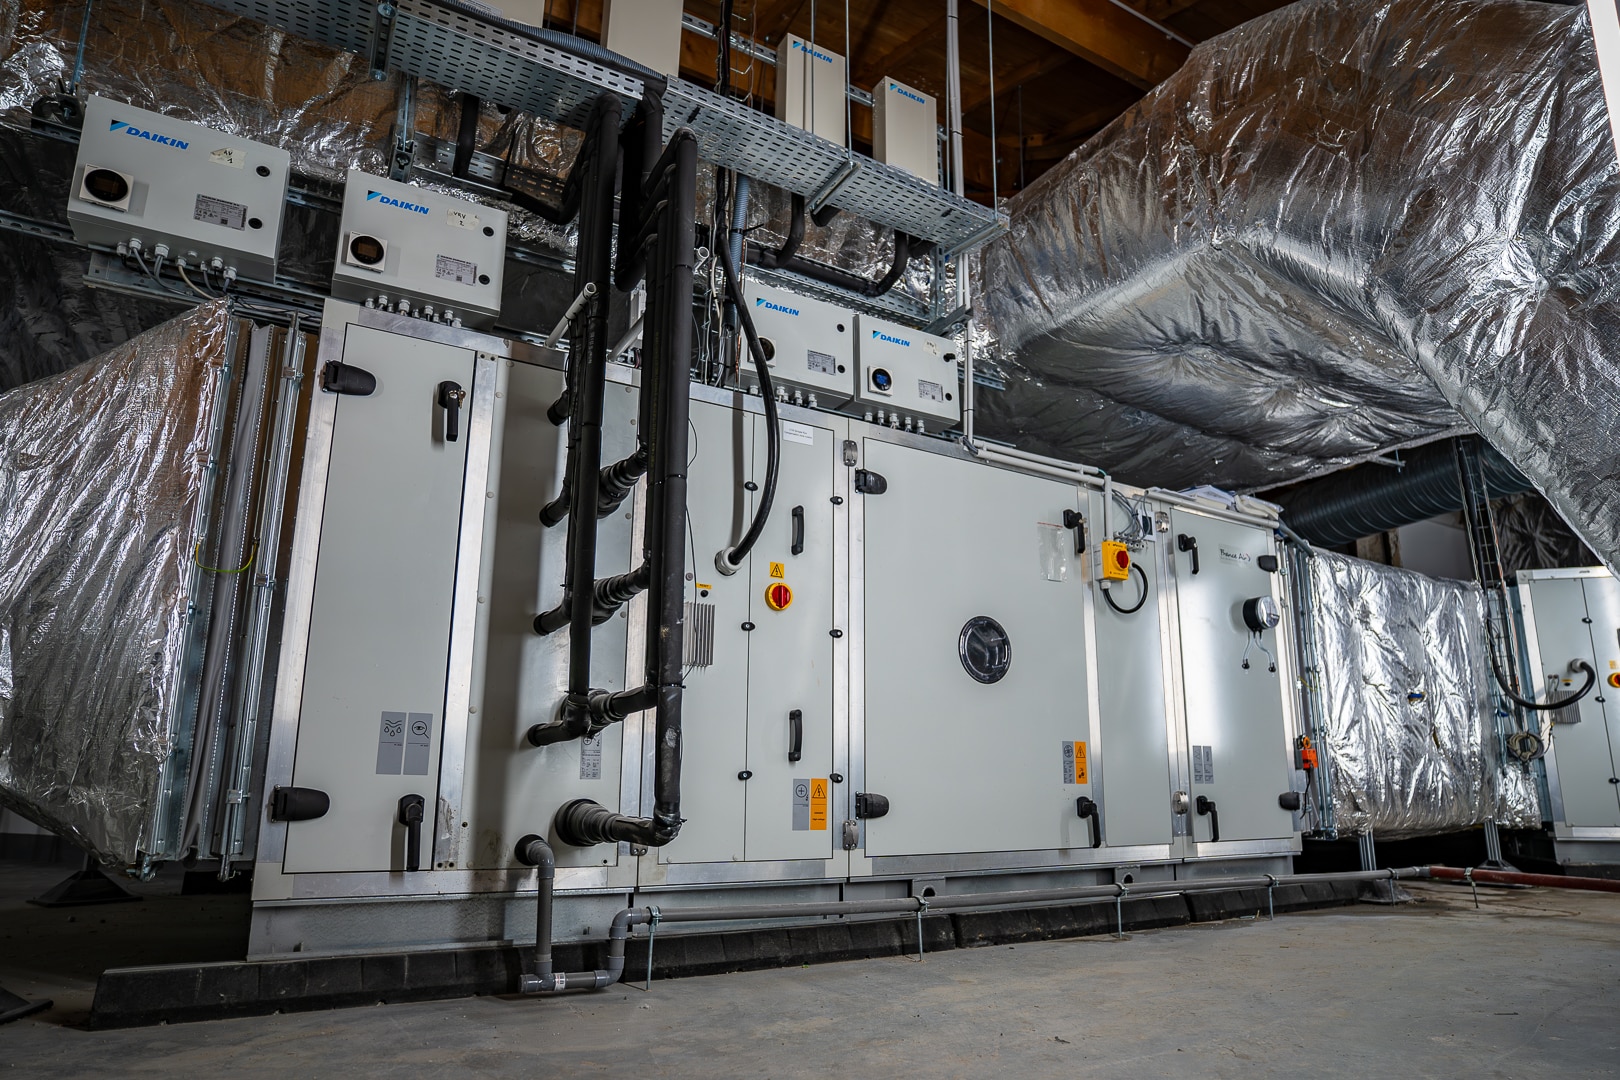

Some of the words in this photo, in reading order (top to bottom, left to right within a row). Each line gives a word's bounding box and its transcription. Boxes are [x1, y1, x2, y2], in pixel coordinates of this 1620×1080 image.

[800, 45, 832, 63] DAIKIN
[897, 87, 925, 104] DAIKIN
[126, 126, 189, 150] DAIKIN
[379, 196, 430, 215] DAIKIN
[764, 301, 799, 316] DAIKIN
[880, 333, 910, 347] DAIKIN
